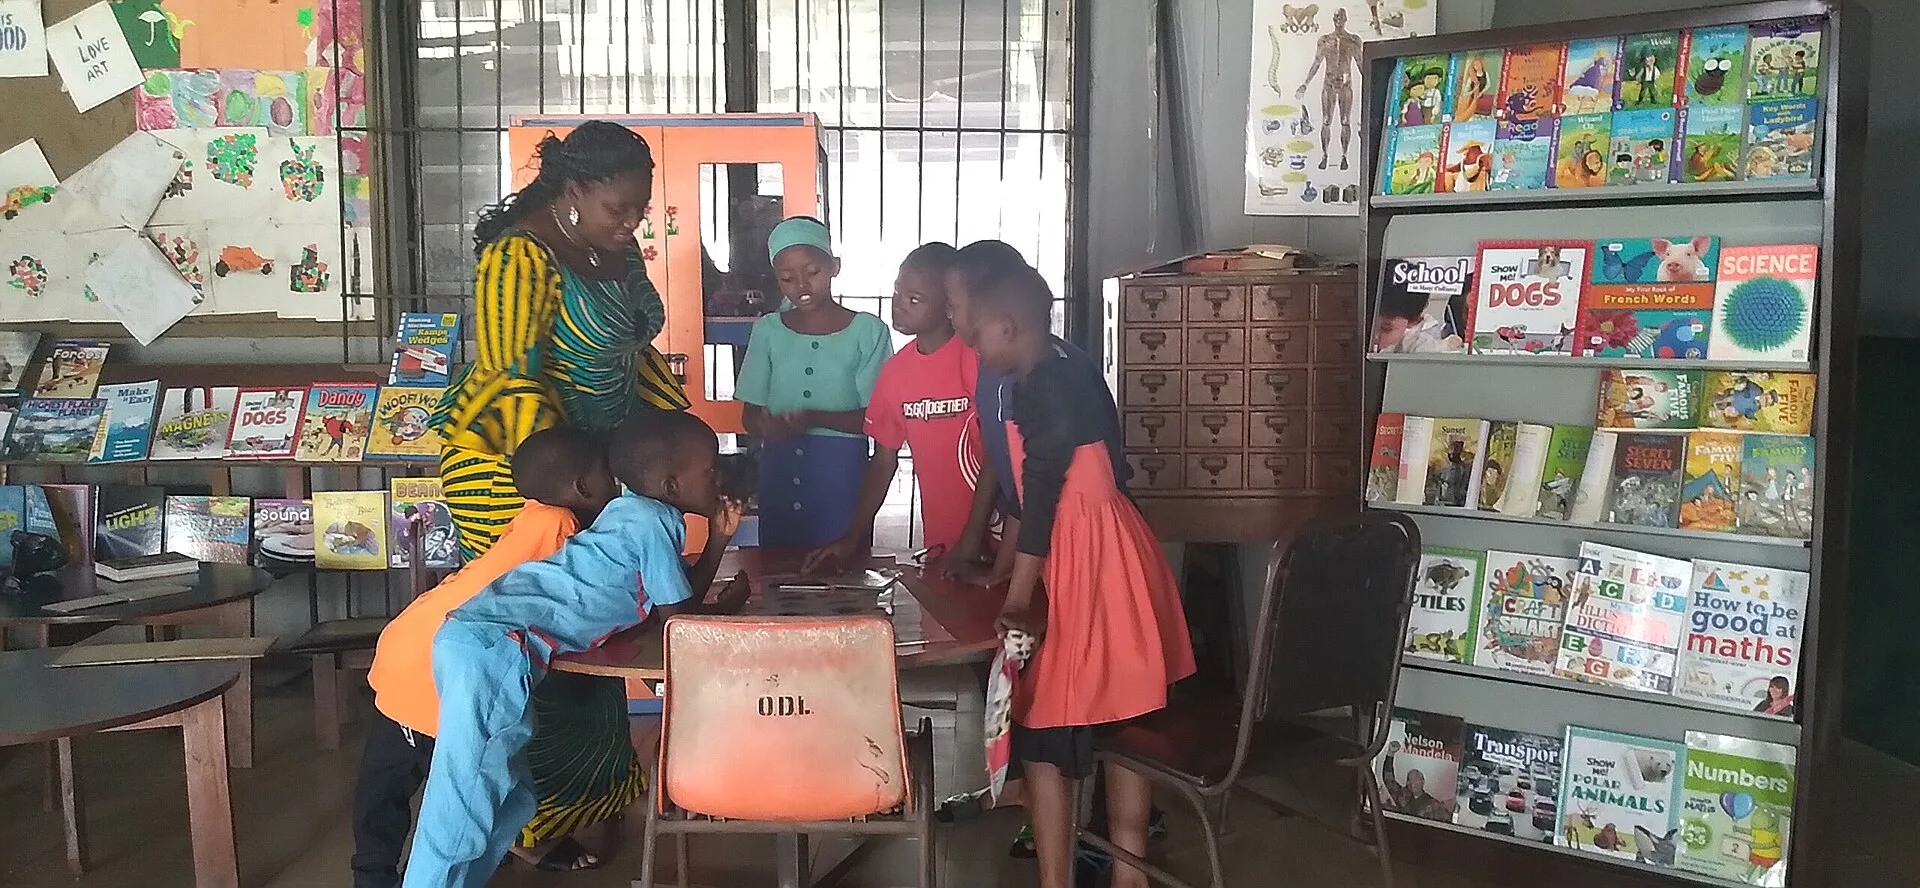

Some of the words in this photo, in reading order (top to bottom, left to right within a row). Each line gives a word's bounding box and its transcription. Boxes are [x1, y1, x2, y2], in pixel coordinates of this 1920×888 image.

[74, 25, 83, 40] I
[78, 36, 111, 64] LOVE
[86, 59, 111, 83] ART
[1508, 121, 1538, 132] Read
[1763, 114, 1804, 124] Ladybird
[1393, 259, 1469, 285] School
[1722, 253, 1813, 275] SCIENCE
[1489, 282, 1563, 308] DOGS
[1604, 295, 1649, 304] French
[1653, 294, 1696, 304] Words
[408, 336, 448, 345] Wedges
[417, 328, 449, 336] Ramps
[53, 347, 104, 360] Forces
[117, 387, 149, 397] Make
[129, 394, 154, 406] Easy
[318, 390, 366, 408] Dandy
[1676, 374, 1689, 420] FAMOUS
[378, 393, 417, 416] WOOF!
[1668, 388, 1681, 418] FIVE
[1778, 392, 1789, 422] FIVE
[1788, 380, 1799, 425] FAMOUS
[58, 408, 94, 416] PLANET
[241, 410, 288, 427] DOGS
[162, 411, 229, 433] MAGNETS
[1441, 425, 1468, 435] Sunset
[1627, 446, 1674, 458] SECRET
[1624, 457, 1674, 471] SEVEN
[106, 505, 159, 531] LIGHT
[259, 508, 311, 521] Sound
[1581, 559, 1596, 574] A
[1605, 583, 1619, 597] C
[1504, 598, 1561, 618] CRAFT
[1661, 595, 1675, 609] D
[1694, 591, 1741, 611] How
[1746, 601, 1765, 614] to
[1771, 601, 1799, 621] be
[1499, 616, 1562, 639] SMART
[1691, 609, 1769, 636] good
[1775, 624, 1796, 639] at
[1568, 636, 1580, 650] E
[1687, 632, 1793, 668] maths
[1590, 660, 1604, 676] G
[1404, 732, 1444, 749] Nelson
[1400, 743, 1455, 763] Mandela
[1573, 774, 1621, 790] POLAR
[1688, 759, 1788, 794] Numbers
[1571, 785, 1665, 814] ANIMALS
